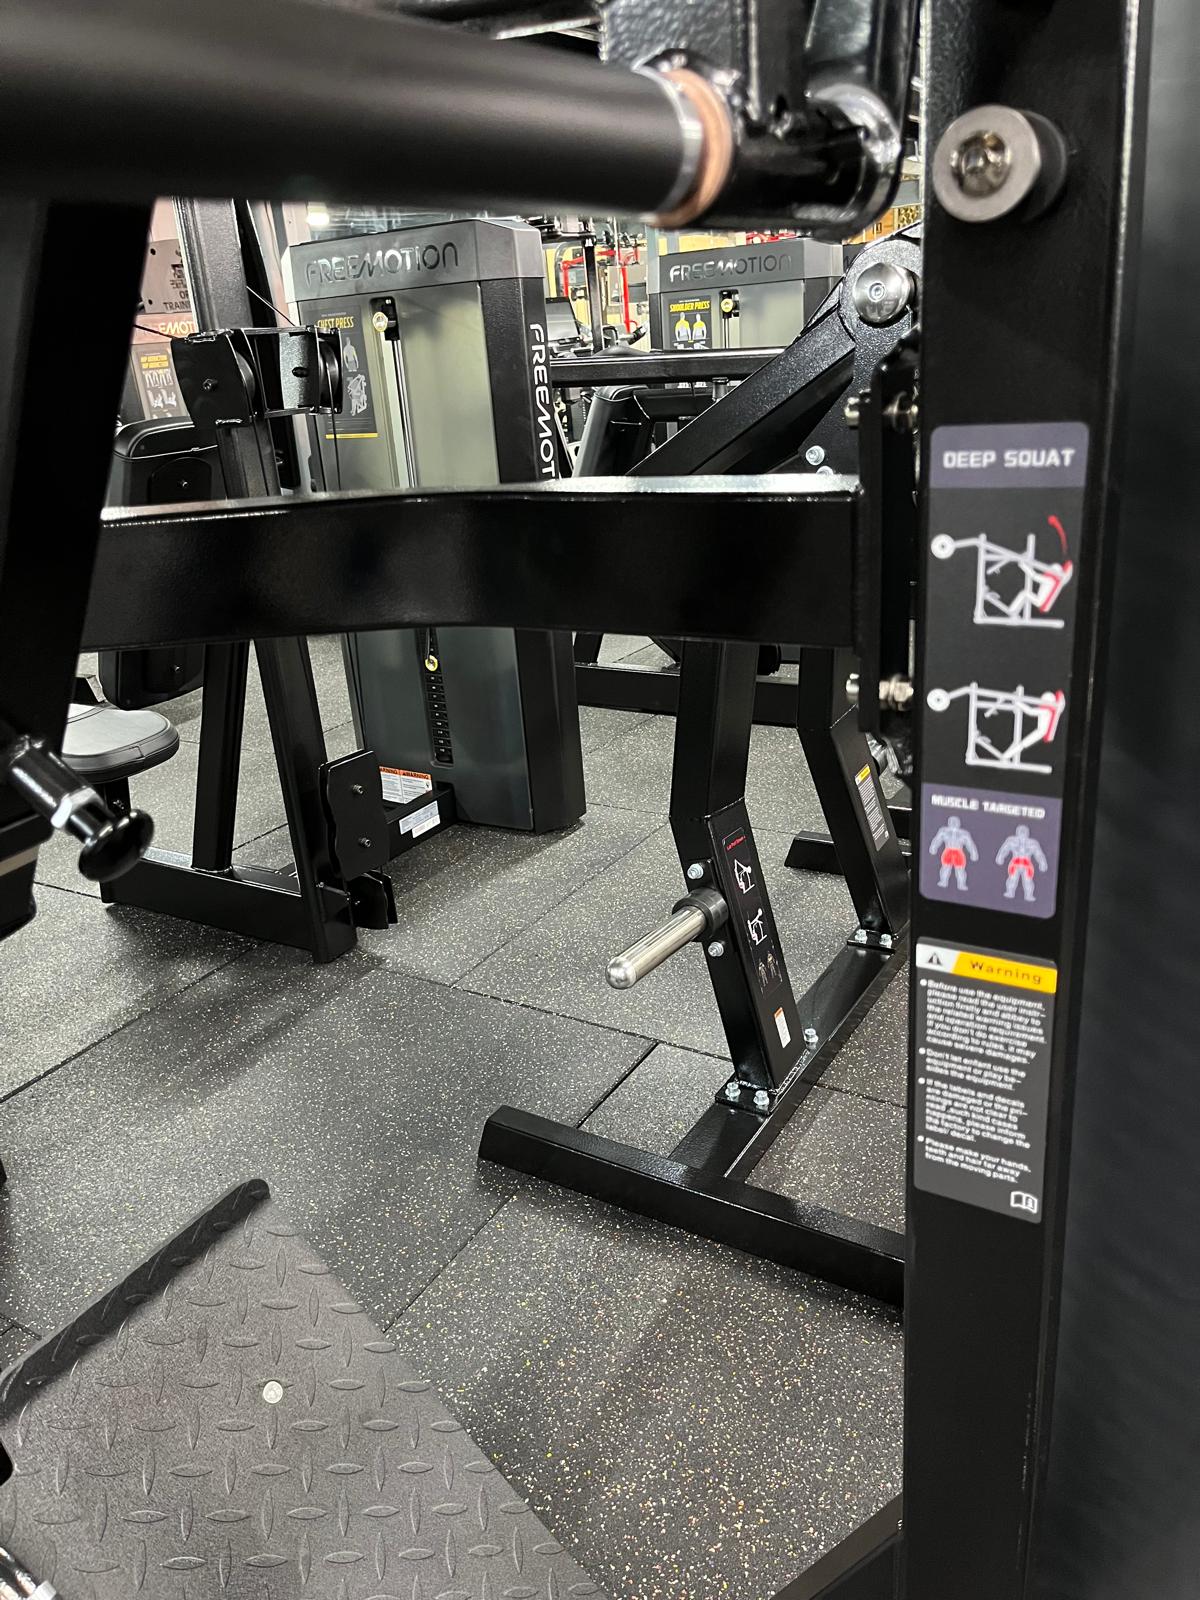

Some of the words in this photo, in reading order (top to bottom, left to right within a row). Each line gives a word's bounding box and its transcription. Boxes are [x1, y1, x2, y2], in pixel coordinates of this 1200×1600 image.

[305, 241, 460, 288] FREEMOTION
[669, 253, 792, 284] FREEMOTION
[163, 301, 191, 311] TRAIN
[335, 316, 355, 329] PRESS
[529, 323, 556, 478] FREEMOT
[943, 450, 997, 468] DEEP
[1003, 448, 1075, 468] SQUAT
[931, 794, 979, 811] MUSCLE
[982, 801, 1046, 820] TARGETED
[969, 960, 1042, 985] Warning
